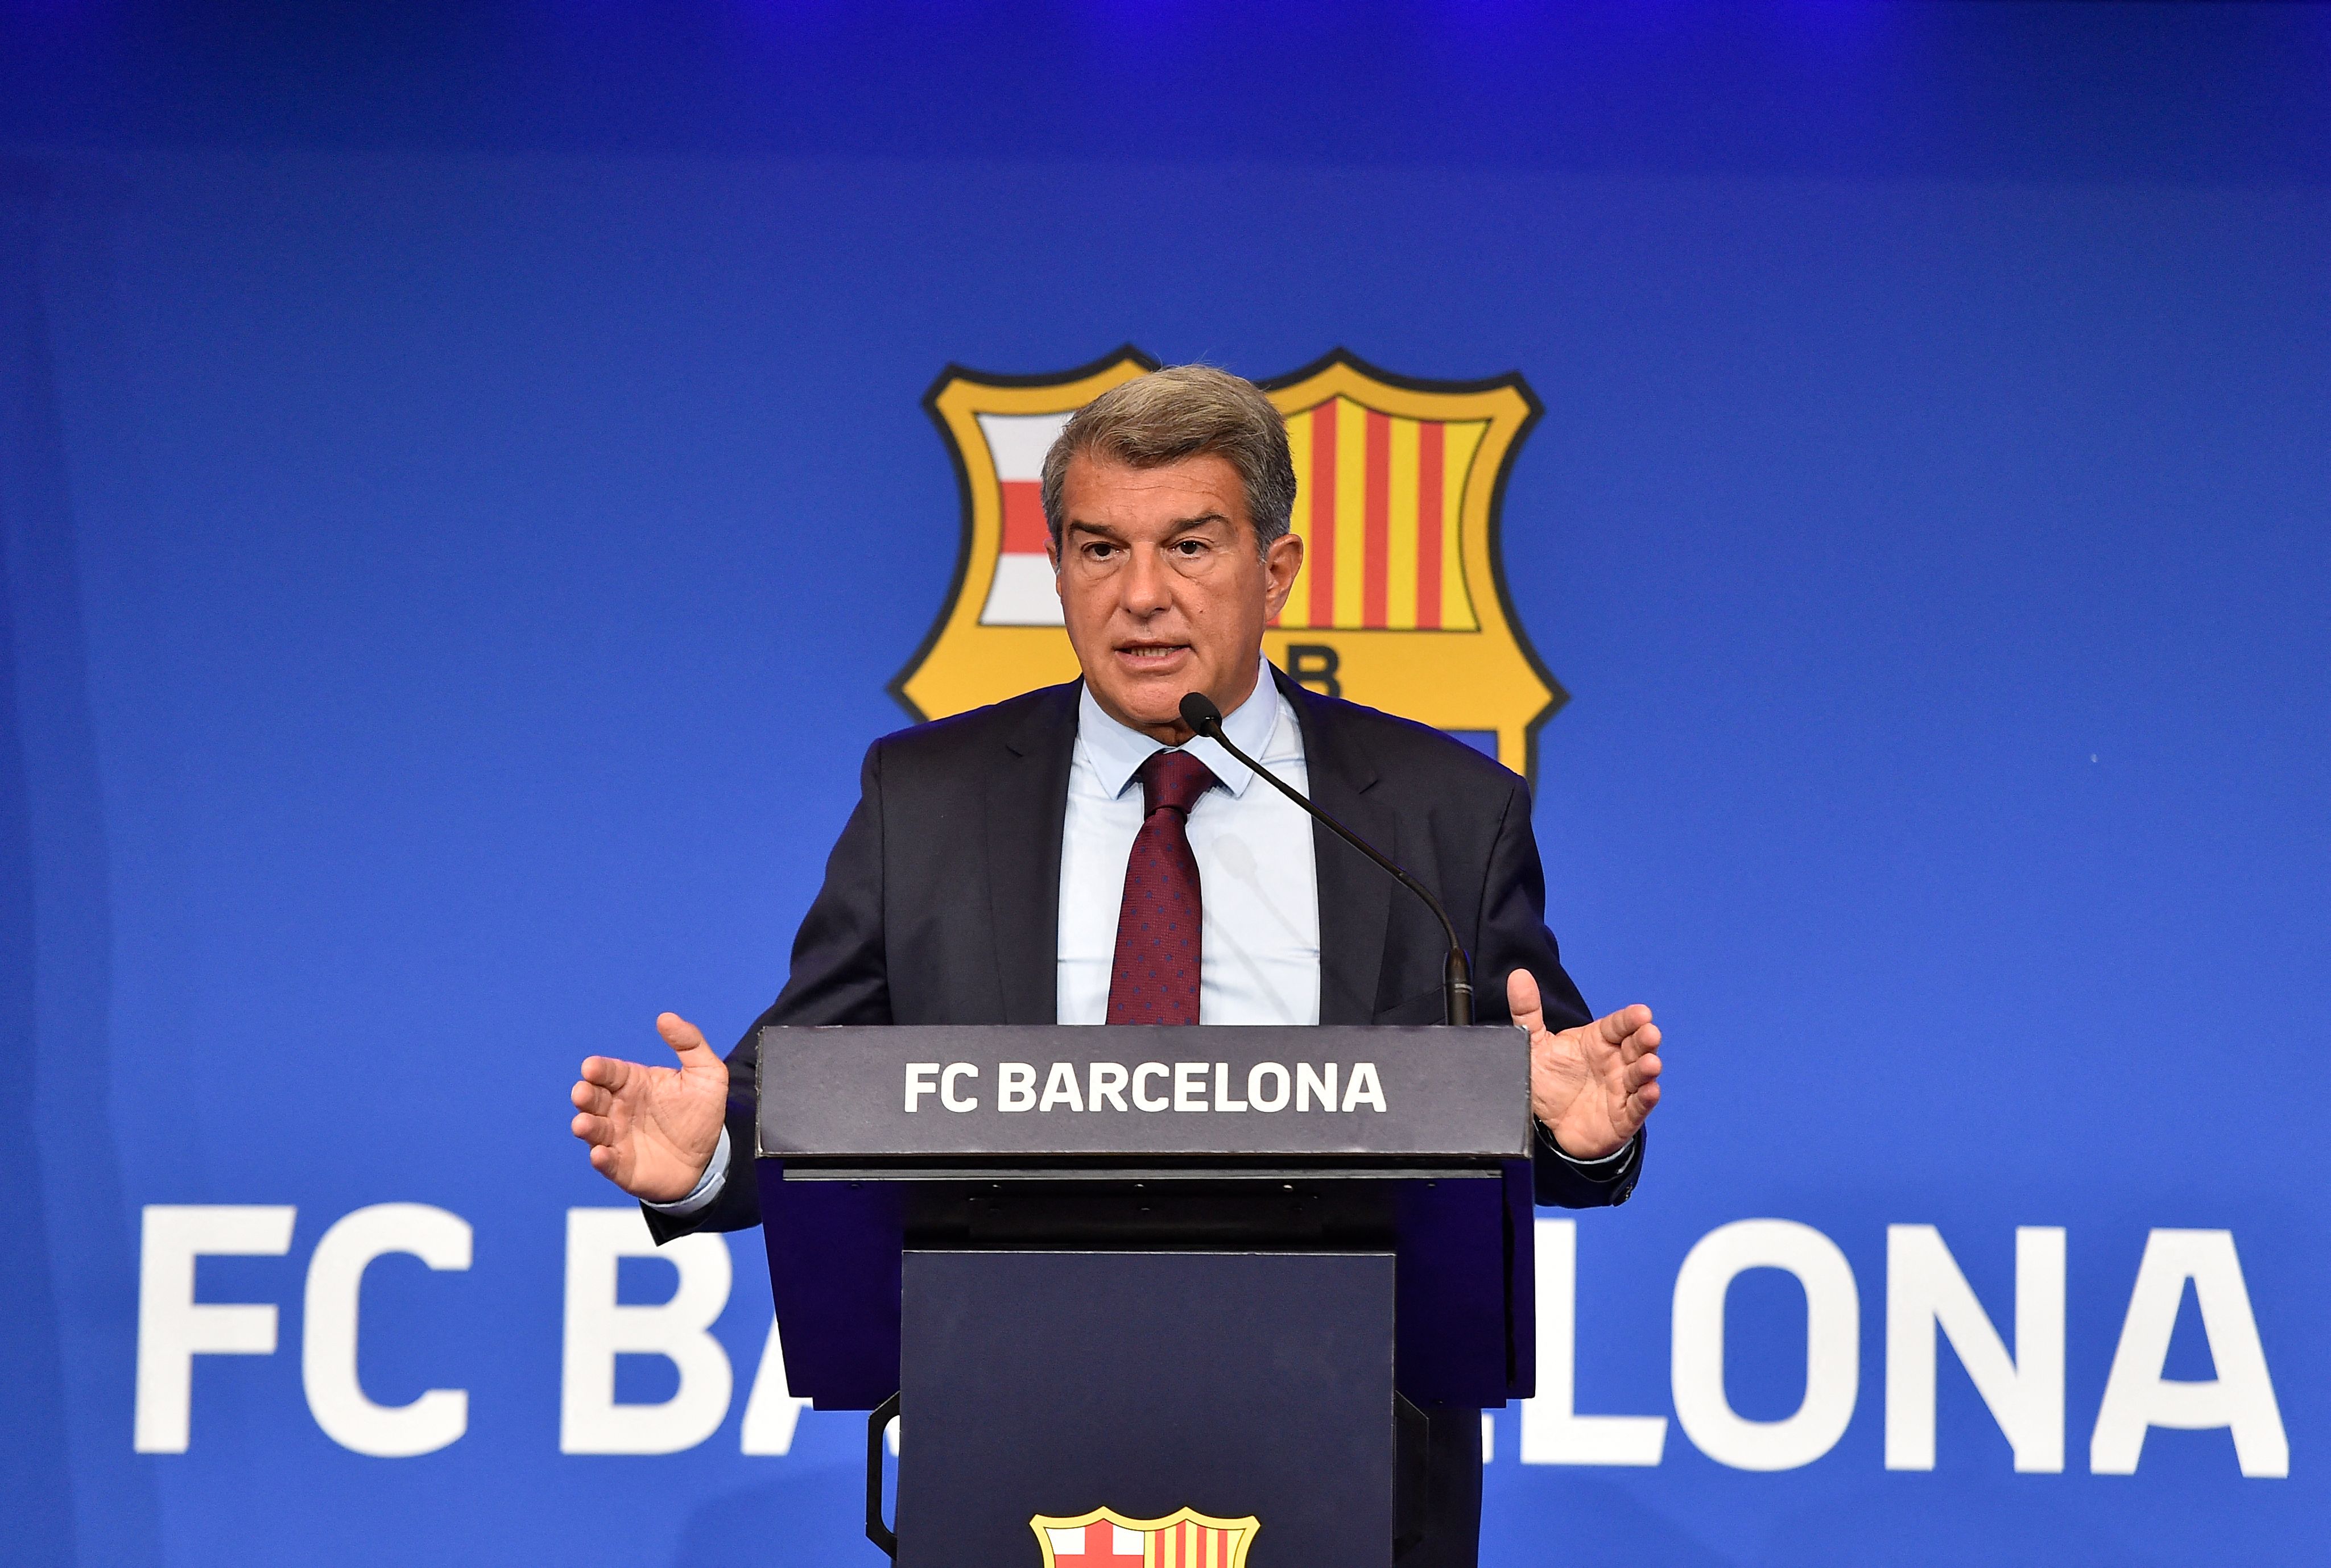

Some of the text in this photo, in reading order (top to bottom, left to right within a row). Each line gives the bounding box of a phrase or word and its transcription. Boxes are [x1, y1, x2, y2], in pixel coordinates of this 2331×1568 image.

[904, 1062, 1387, 1113] FC BARCELONA
[134, 1202, 2290, 1478] FC BLONA
